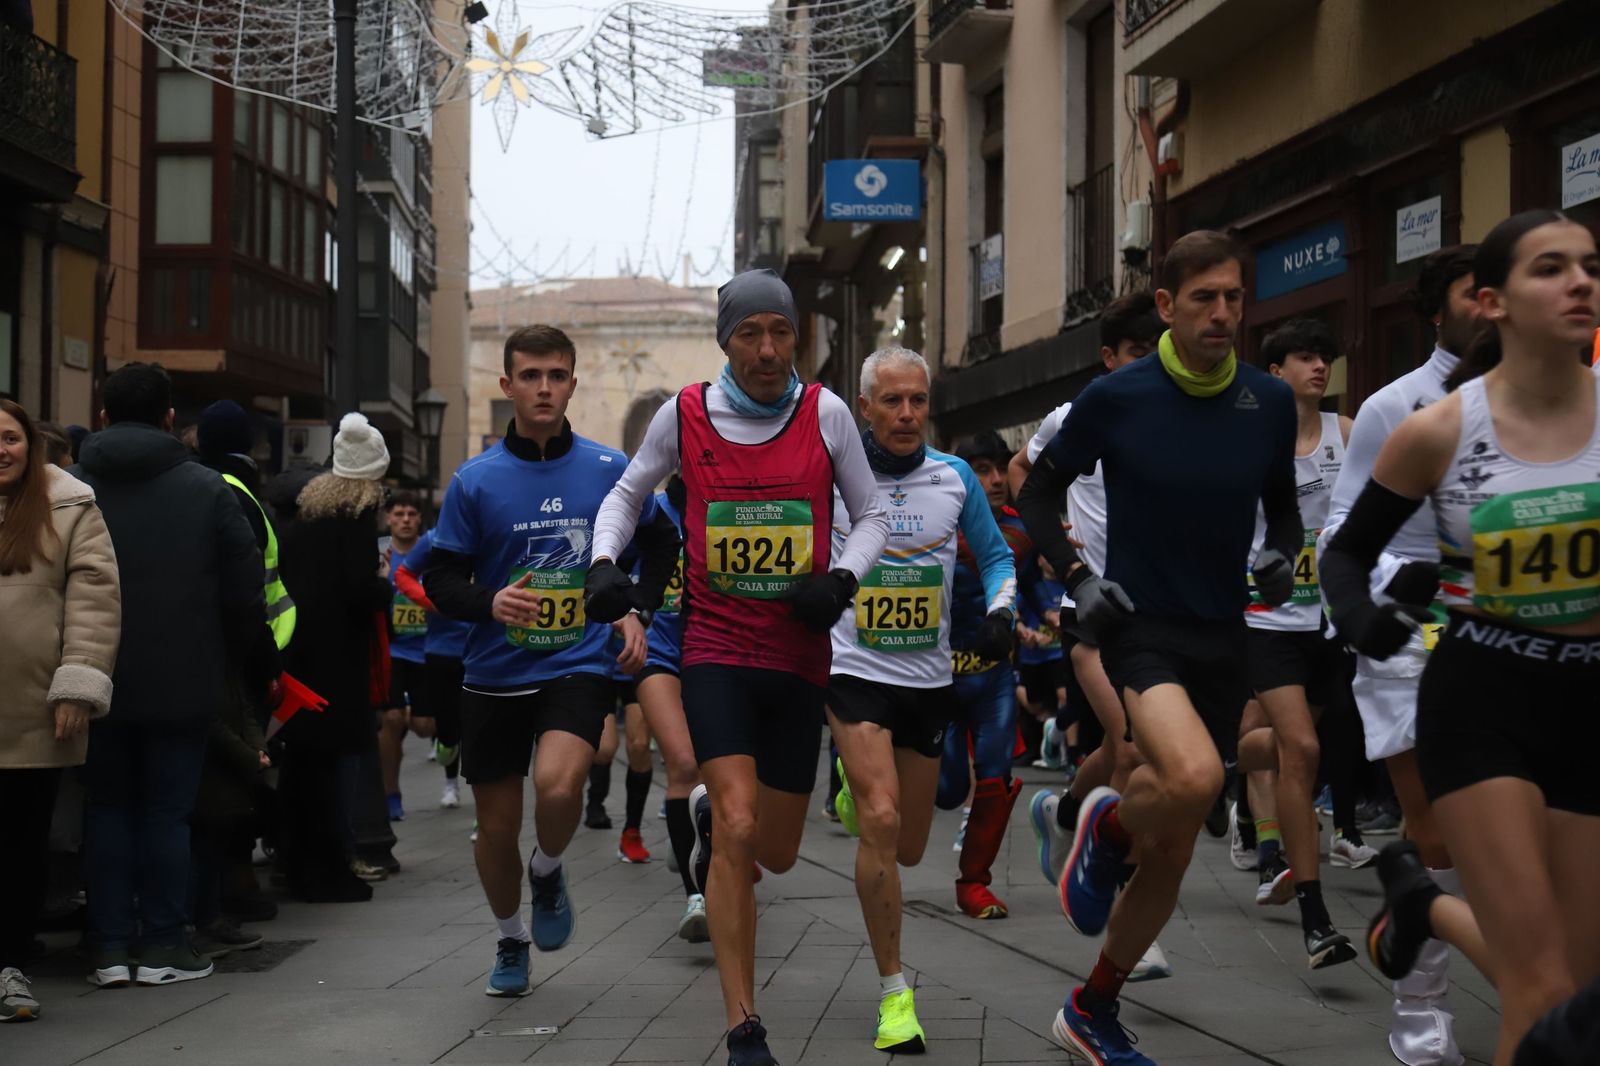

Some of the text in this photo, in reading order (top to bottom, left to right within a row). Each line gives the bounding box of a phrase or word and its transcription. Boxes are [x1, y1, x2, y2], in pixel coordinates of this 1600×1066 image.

[830, 203, 913, 217] Samsonite
[1283, 242, 1324, 274] NUXE
[540, 497, 563, 514] 46
[735, 512, 784, 521] CAJA RURAL
[513, 523, 529, 532] SAN
[530, 519, 569, 529] SILVESTRE
[713, 536, 796, 575] 1324
[736, 581, 791, 591] CAJA RUR
[536, 597, 577, 628] 93
[862, 596, 929, 629] 1255
[1517, 602, 1561, 618] CAJA
[528, 632, 578, 644] CAJA RURAL
[881, 634, 934, 645] CAJA RURAL
[1455, 620, 1600, 663] NIKE PR
